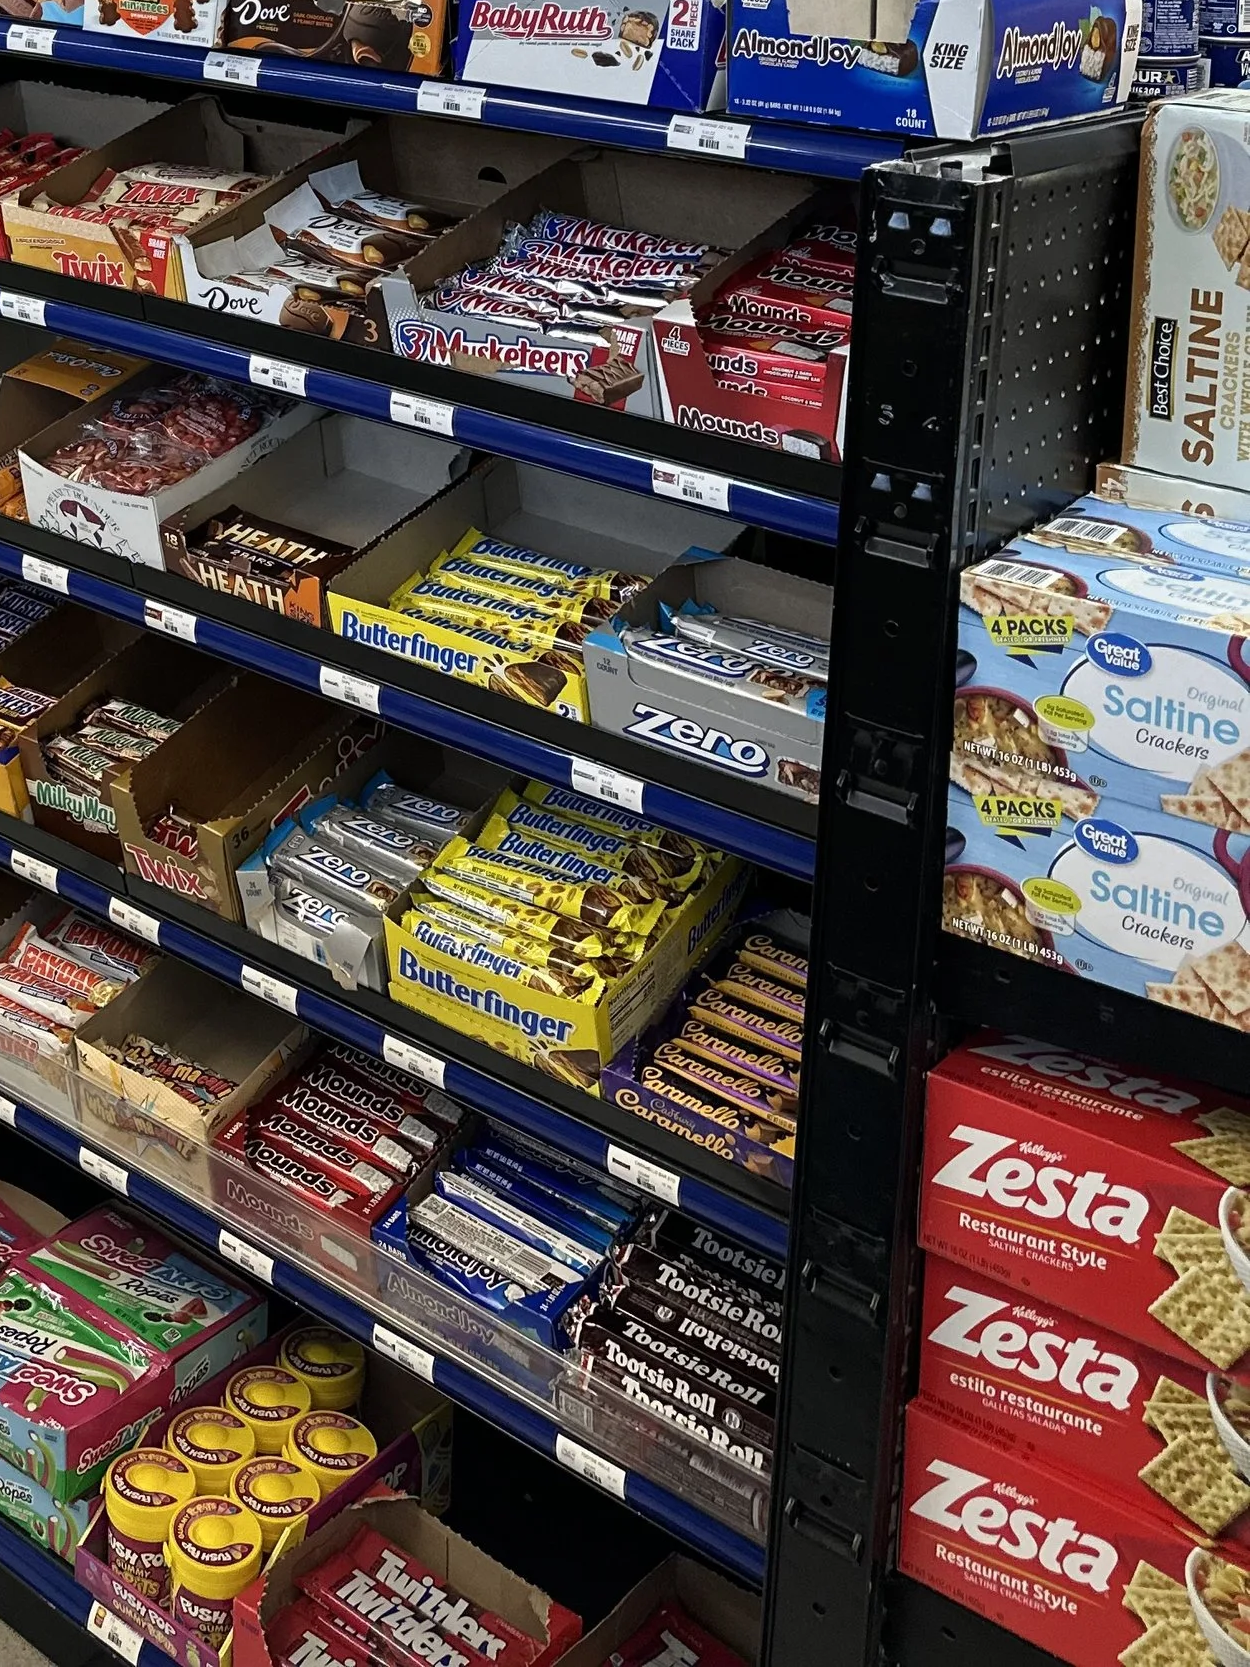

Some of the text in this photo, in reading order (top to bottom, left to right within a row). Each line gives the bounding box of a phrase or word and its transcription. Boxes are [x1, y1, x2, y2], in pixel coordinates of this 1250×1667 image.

[670, 28, 695, 39] SHARE
[671, 0, 698, 28] 2 PIECE
[670, 37, 694, 49] PACK
[929, 56, 965, 70] SIZE
[932, 43, 968, 57] KING
[896, 118, 926, 129] COUNT
[906, 109, 917, 118] 18
[147, 237, 167, 250] SHARE
[153, 248, 166, 259] SIZE
[364, 319, 378, 343] 3
[661, 337, 690, 352] PIECES
[668, 326, 681, 341] 4
[1153, 324, 1173, 416] Best Choice
[1181, 288, 1224, 466] SALTINE
[1220, 332, 1241, 430] CRACKERS
[677, 405, 779, 447] Mounds
[165, 532, 178, 546] 18
[217, 523, 328, 565] HEATH
[198, 562, 286, 615] HEATH
[342, 611, 479, 675] Butterfinger
[991, 619, 1068, 635] 4 PACKS
[595, 662, 618, 677] COUNT
[601, 656, 612, 670] 12
[1094, 639, 1141, 662] Great
[1104, 653, 1141, 671] Value
[1103, 685, 1240, 745] Saltine
[1187, 686, 1245, 713] Original
[964, 741, 979, 753] NET
[980, 745, 997, 758] WT
[999, 752, 1010, 763] 16
[1010, 755, 1024, 766] OZ
[1036, 760, 1052, 774] LB)
[1053, 766, 1077, 782] 453g
[1135, 728, 1209, 760] Crackers
[507, 801, 626, 854] Butterfinger
[981, 801, 1056, 818] 4 PACKS
[1082, 824, 1127, 850] Great
[1092, 840, 1127, 858] Value
[497, 832, 623, 885] Butterfinger
[1090, 870, 1224, 937] Saltine
[1173, 877, 1230, 906] Original
[952, 918, 968, 931] NET
[968, 923, 984, 935] WT
[986, 929, 997, 940] 16
[999, 933, 1011, 946] OZ
[1023, 941, 1039, 956] LB)
[1040, 947, 1064, 965] 453g
[1122, 916, 1194, 951] Crackers
[398, 946, 575, 1044] Butterfinger
[696, 989, 803, 1044] Caramello
[682, 1020, 785, 1076] Caramello
[655, 1042, 761, 1099] Caramello
[968, 1035, 1200, 1114] Zesta
[302, 1063, 405, 1124] Mounds
[642, 1066, 741, 1130] Caramello
[650, 1097, 697, 1130] Cadbury
[980, 1066, 1144, 1122] estilo restaurante
[277, 1086, 379, 1145] Mounds
[615, 1088, 734, 1161] Caramello
[931, 1124, 1149, 1244] Zesta
[692, 1226, 779, 1285] Tootsie
[959, 1212, 1108, 1270] Restaurant Style
[988, 1238, 1024, 1256] SALTINE
[1026, 1251, 1074, 1272] CRACKERS
[116, 1276, 180, 1306] Ropes
[655, 1263, 743, 1322] Tootsie
[623, 1321, 767, 1406] Tootsie Roll
[927, 1286, 1139, 1411] Zesta
[604, 1339, 717, 1418] Tootsie Roll
[950, 1372, 996, 1398] estilo
[999, 1388, 1102, 1436] restaurante
[982, 1398, 1067, 1434] GALLETAS SALADAS
[909, 1459, 1118, 1592] Zesta
[116, 1559, 151, 1579] GUMMY
[936, 1543, 1028, 1595] Restaurant
[1032, 1580, 1078, 1615] Style
[111, 1580, 176, 1637] PUSH POP
[180, 1597, 229, 1625] PUSH
[375, 1548, 508, 1661] Twizzlers
[964, 1571, 998, 1592] SALTINE
[1000, 1587, 1046, 1613] CRACKERS
[335, 1567, 472, 1667] Twizzlers
